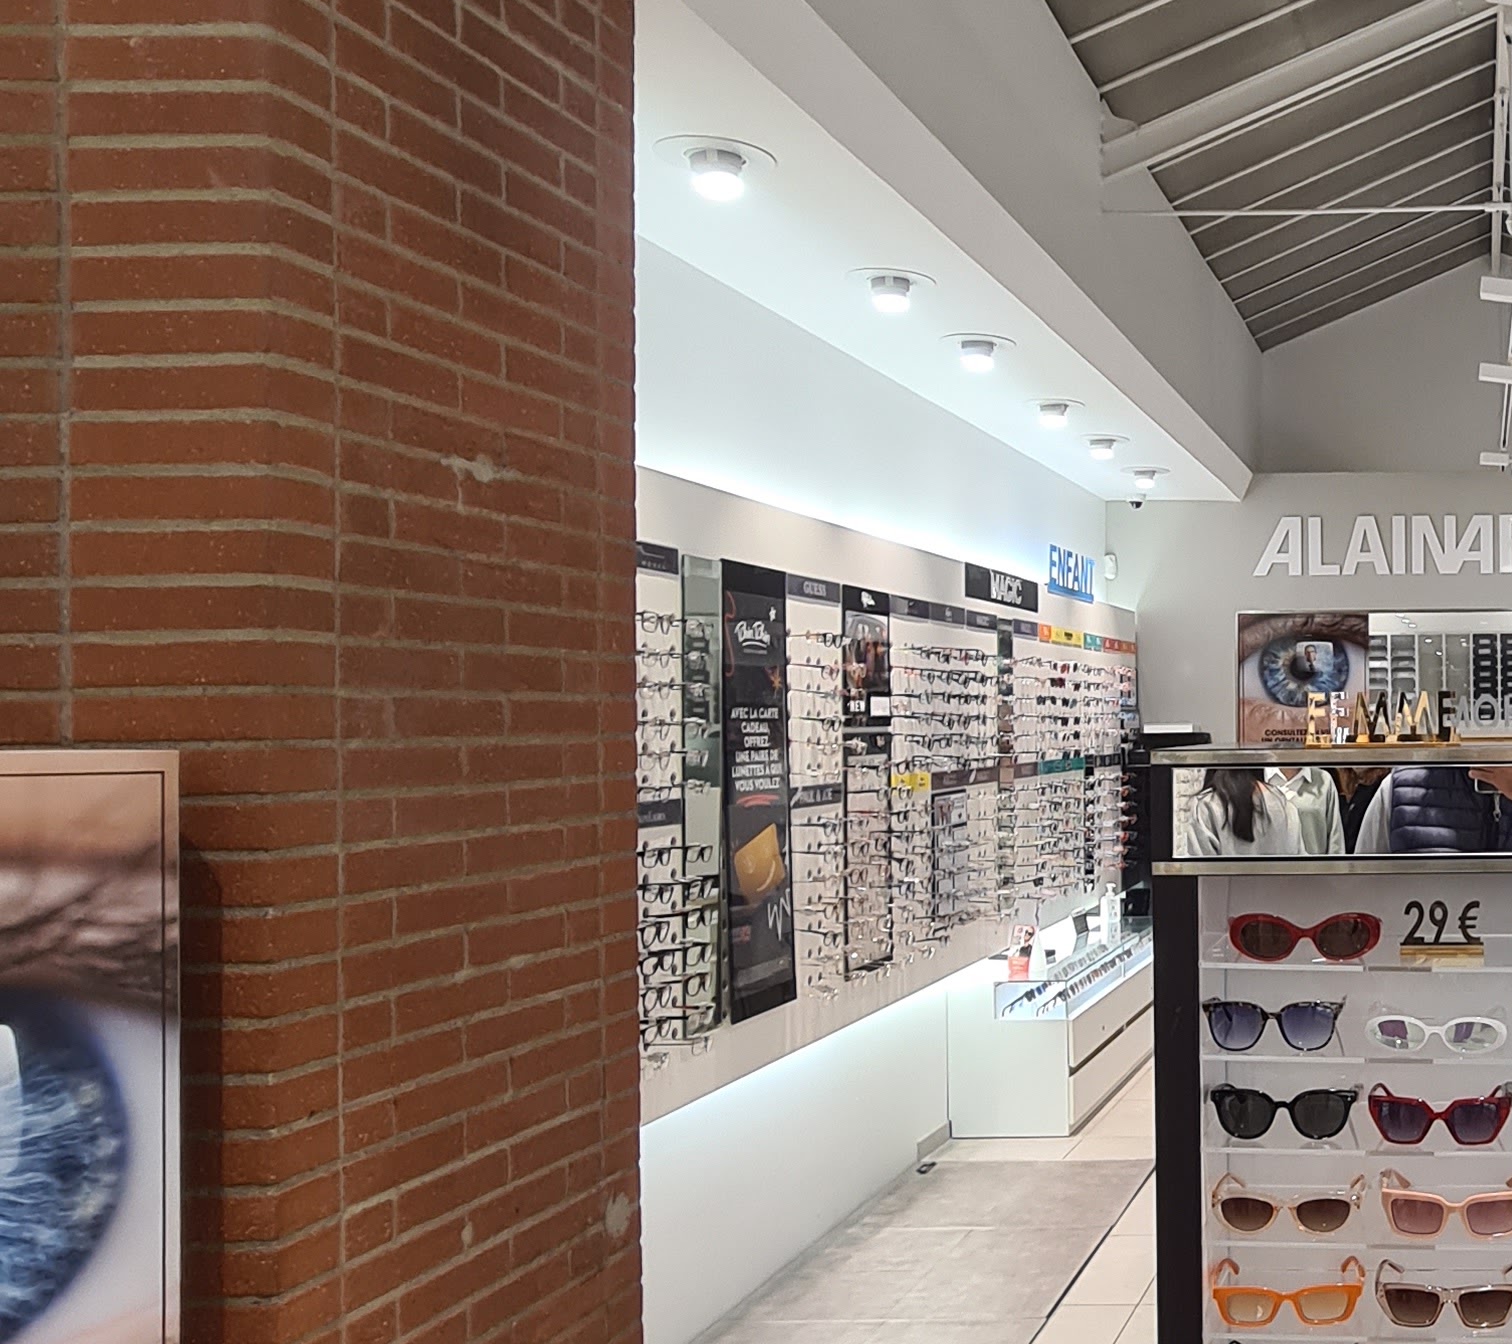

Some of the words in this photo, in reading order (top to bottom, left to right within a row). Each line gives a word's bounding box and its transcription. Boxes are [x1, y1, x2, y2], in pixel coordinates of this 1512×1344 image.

[1048, 543, 1095, 594] ENFANT
[803, 580, 827, 597] GUESS
[989, 567, 1023, 605] MAGIC
[730, 707, 749, 719] AVEC
[749, 708, 758, 719] LA
[759, 707, 779, 719] CARTE
[731, 764, 764, 778] LUNETTES
[734, 778, 754, 792] VOUS
[754, 777, 781, 791] VOULEZ
